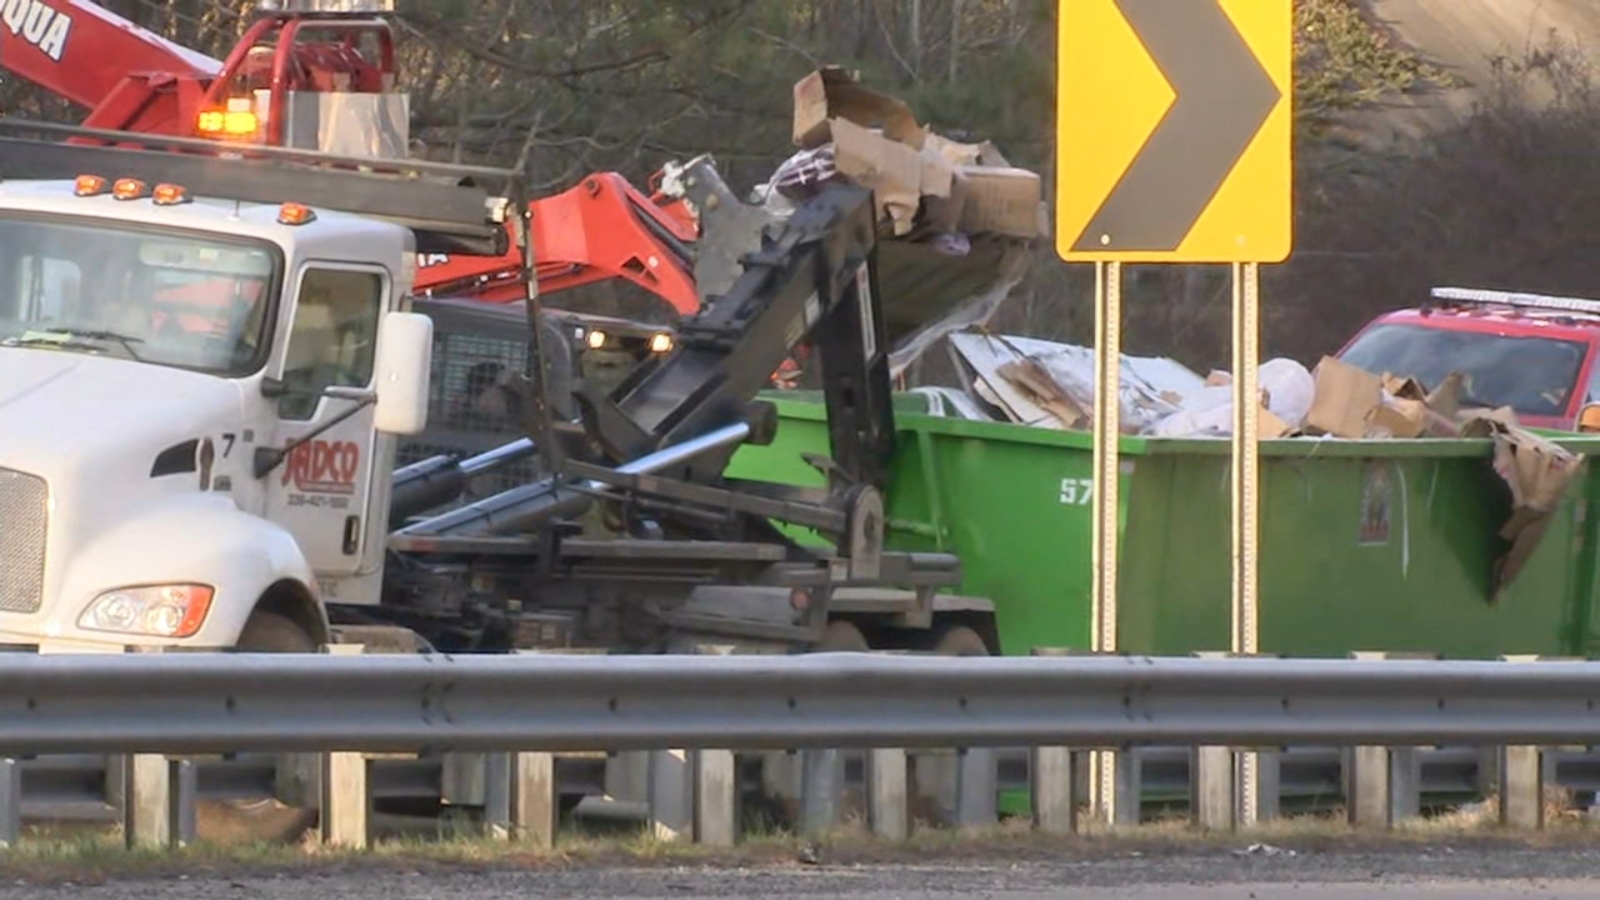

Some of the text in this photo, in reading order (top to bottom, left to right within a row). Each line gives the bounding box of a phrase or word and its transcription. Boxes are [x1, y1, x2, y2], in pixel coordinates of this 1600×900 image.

[0, 0, 71, 61] QUA
[222, 433, 236, 458] 7
[281, 438, 360, 488] JADCO
